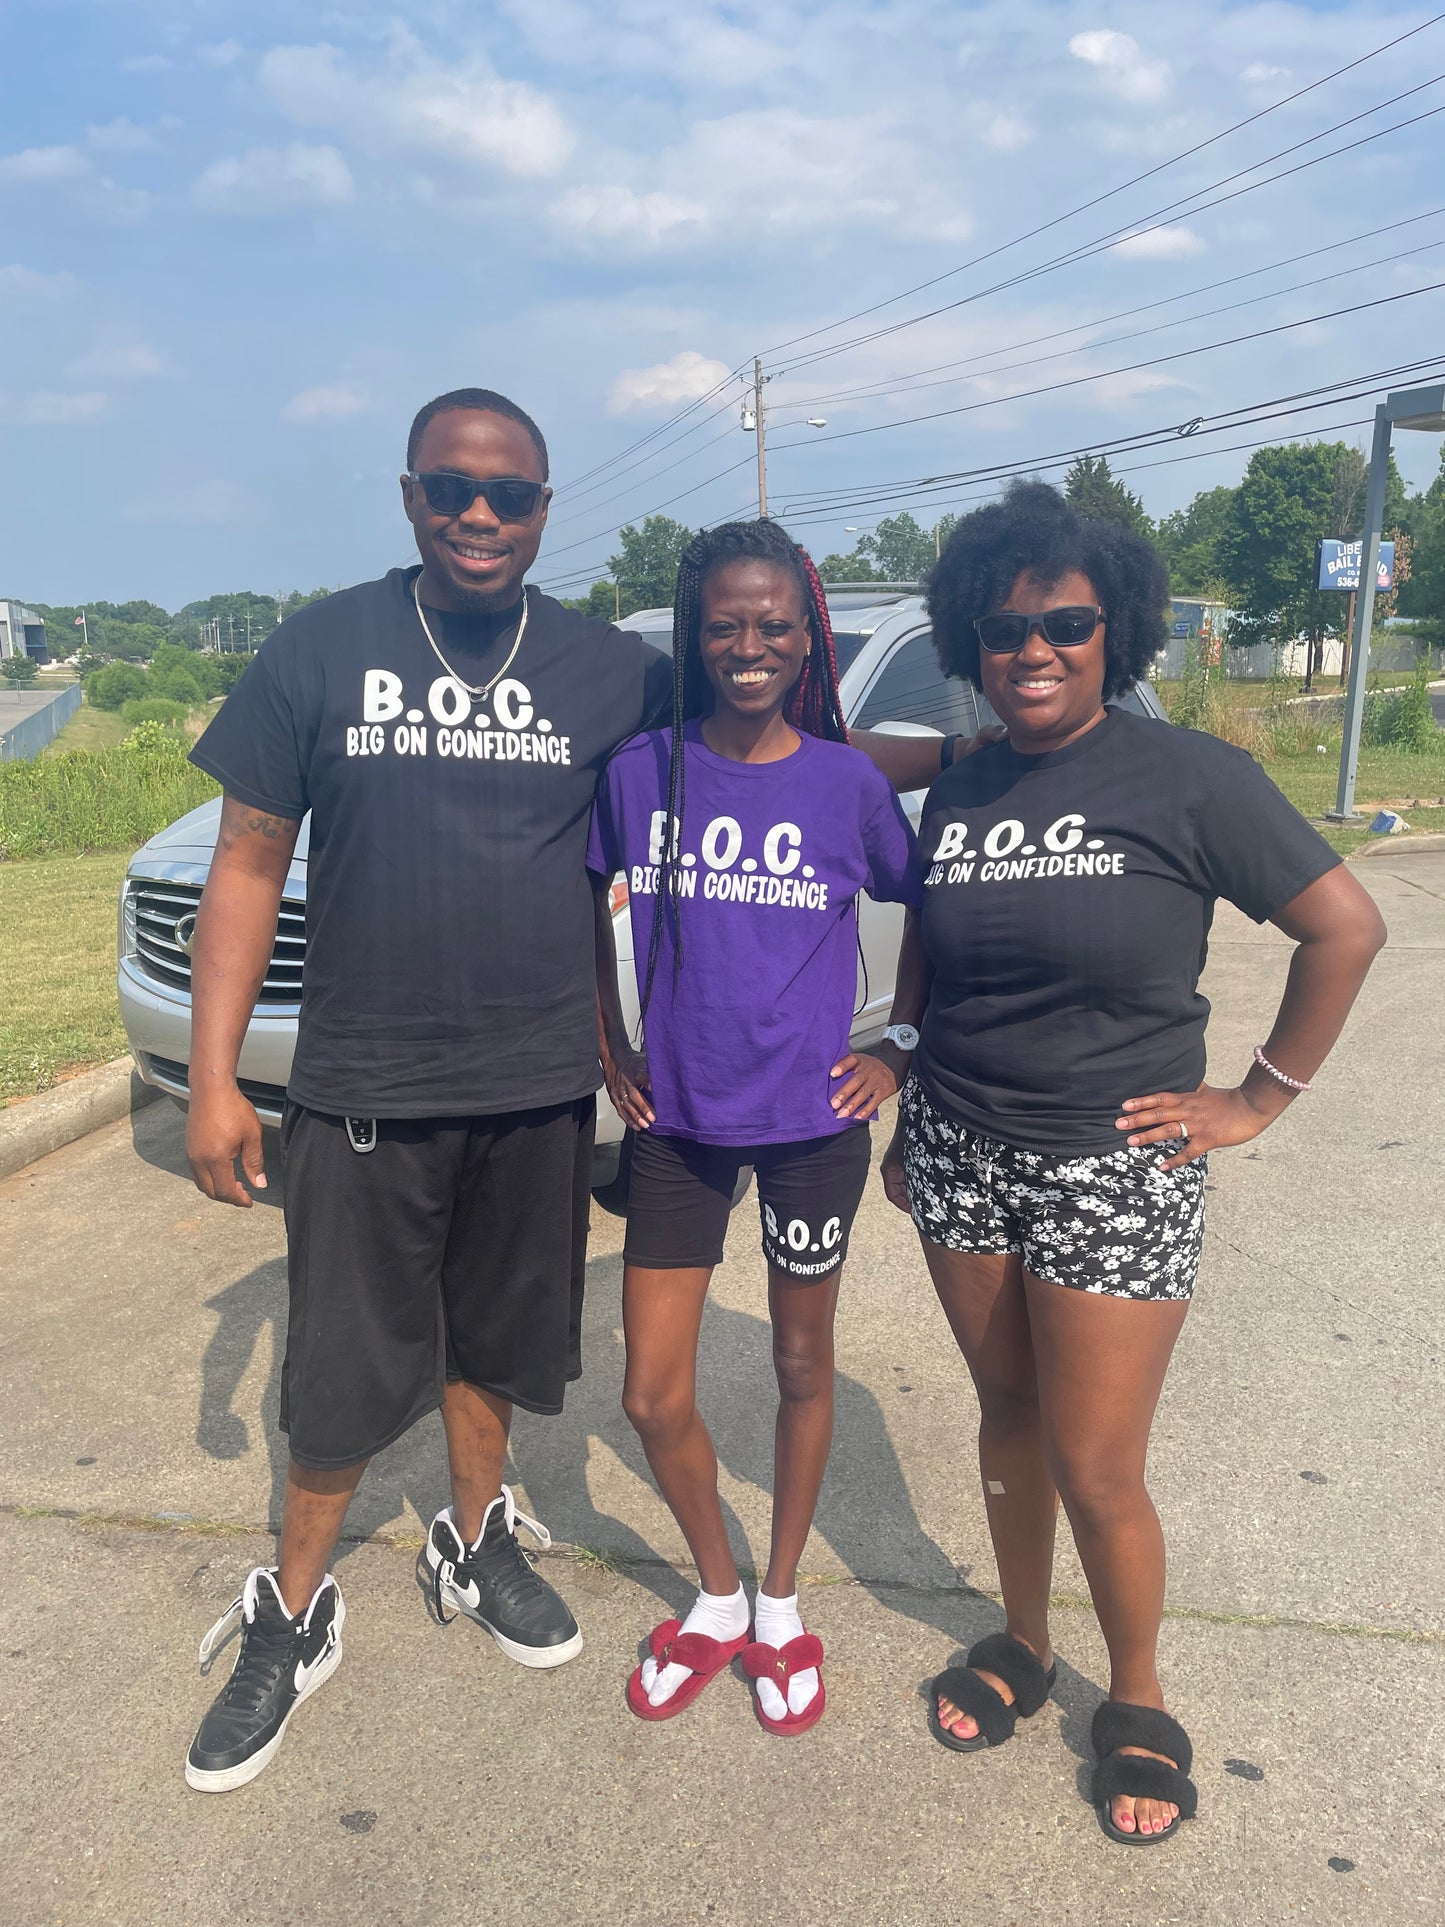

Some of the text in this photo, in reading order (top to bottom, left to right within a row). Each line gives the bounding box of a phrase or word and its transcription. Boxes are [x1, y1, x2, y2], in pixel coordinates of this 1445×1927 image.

[1327, 555, 1354, 575] BAIL
[1337, 576, 1360, 588] 536-6
[363, 669, 552, 732] B.O.C.
[347, 725, 571, 765] BIG ON CONFIDENCE
[648, 810, 815, 878] B.O.C.
[933, 813, 1105, 862] B.O.C.
[947, 862, 976, 884] ON
[980, 853, 1126, 882] CONFIDENCE
[703, 871, 829, 911] CONFIDENCE
[776, 1253, 787, 1268] ON
[789, 1250, 841, 1276] CONFIDENCE
